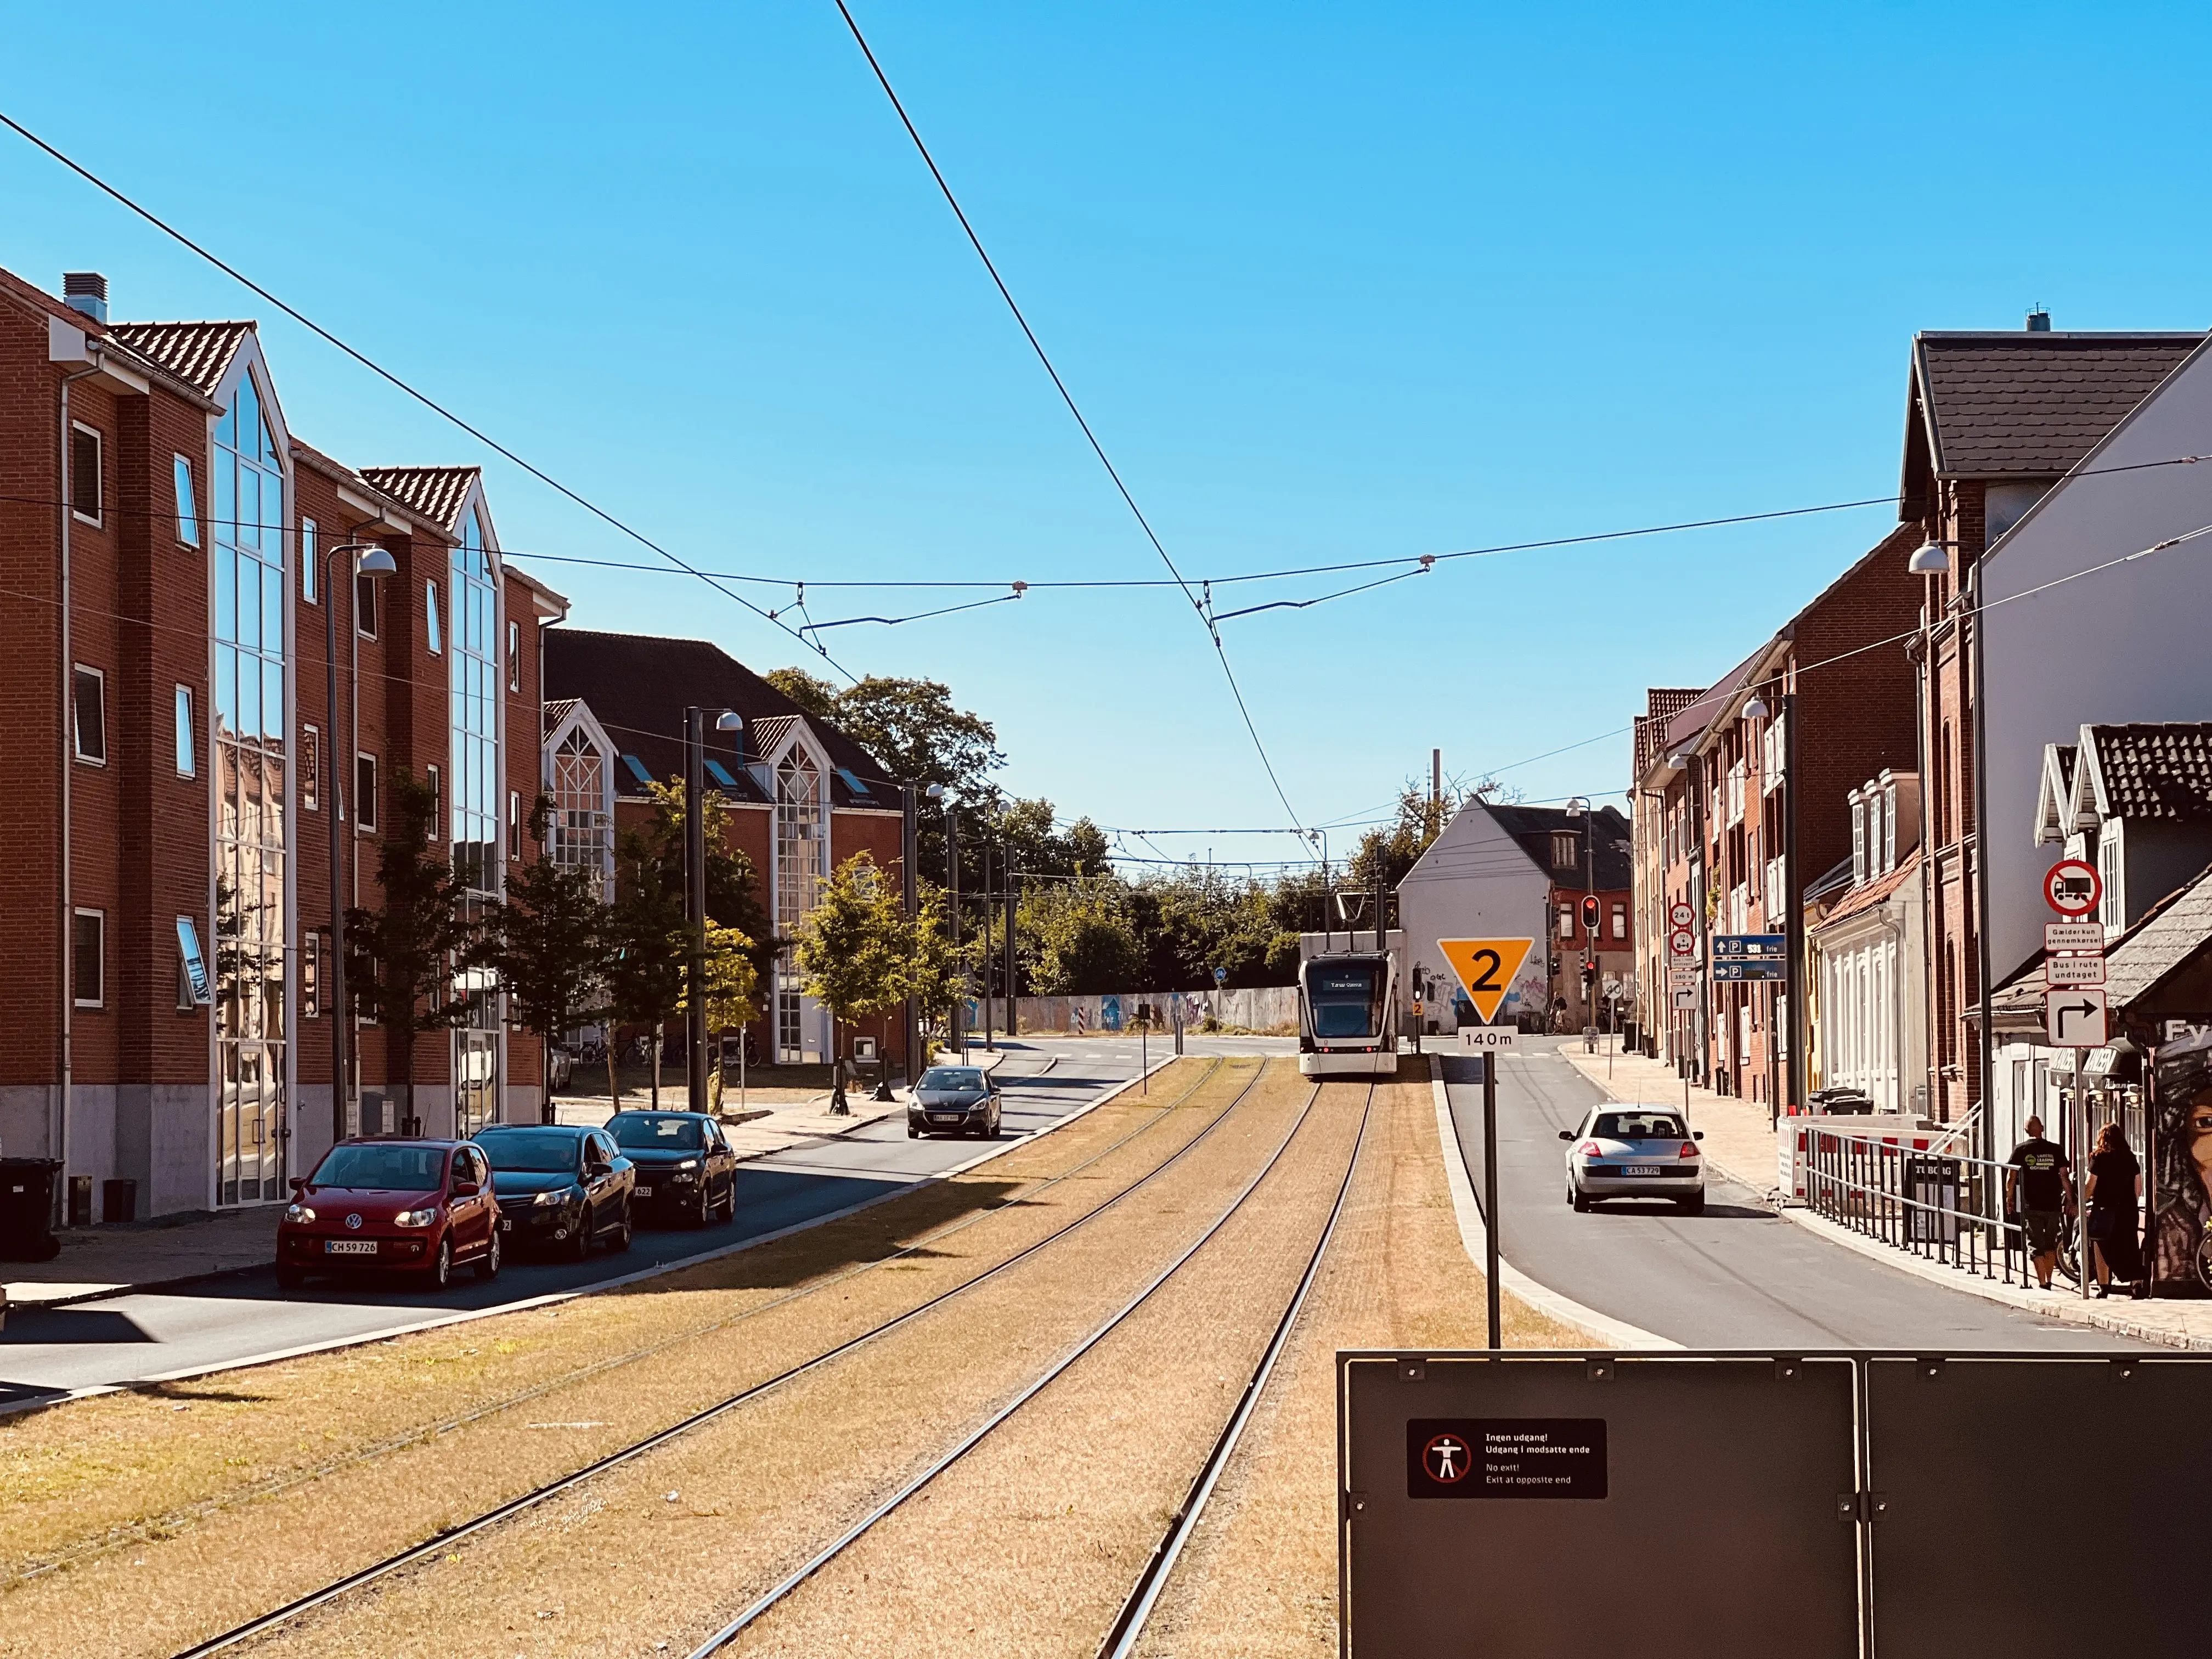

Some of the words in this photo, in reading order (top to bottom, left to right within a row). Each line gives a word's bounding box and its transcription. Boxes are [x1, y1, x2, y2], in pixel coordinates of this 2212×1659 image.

[1471, 949, 1502, 992] 2
[1414, 1004, 1421, 1013] 2
[2165, 1019, 2212, 1047] Fy
[332, 1243, 344, 1251] CH
[346, 1243, 357, 1251] 59
[359, 1243, 376, 1252] 726
[1486, 1433, 1511, 1443] Ingen
[1514, 1433, 1548, 1443] udgang!
[1486, 1444, 1518, 1454] Udgang
[1526, 1445, 1567, 1453] modsatte
[1569, 1446, 1590, 1454] ende
[1486, 1463, 1498, 1471] No
[1500, 1463, 1520, 1471] exit!
[1486, 1475, 1503, 1483] Exit
[1516, 1475, 1553, 1485] opposite
[1555, 1476, 1571, 1484] end
